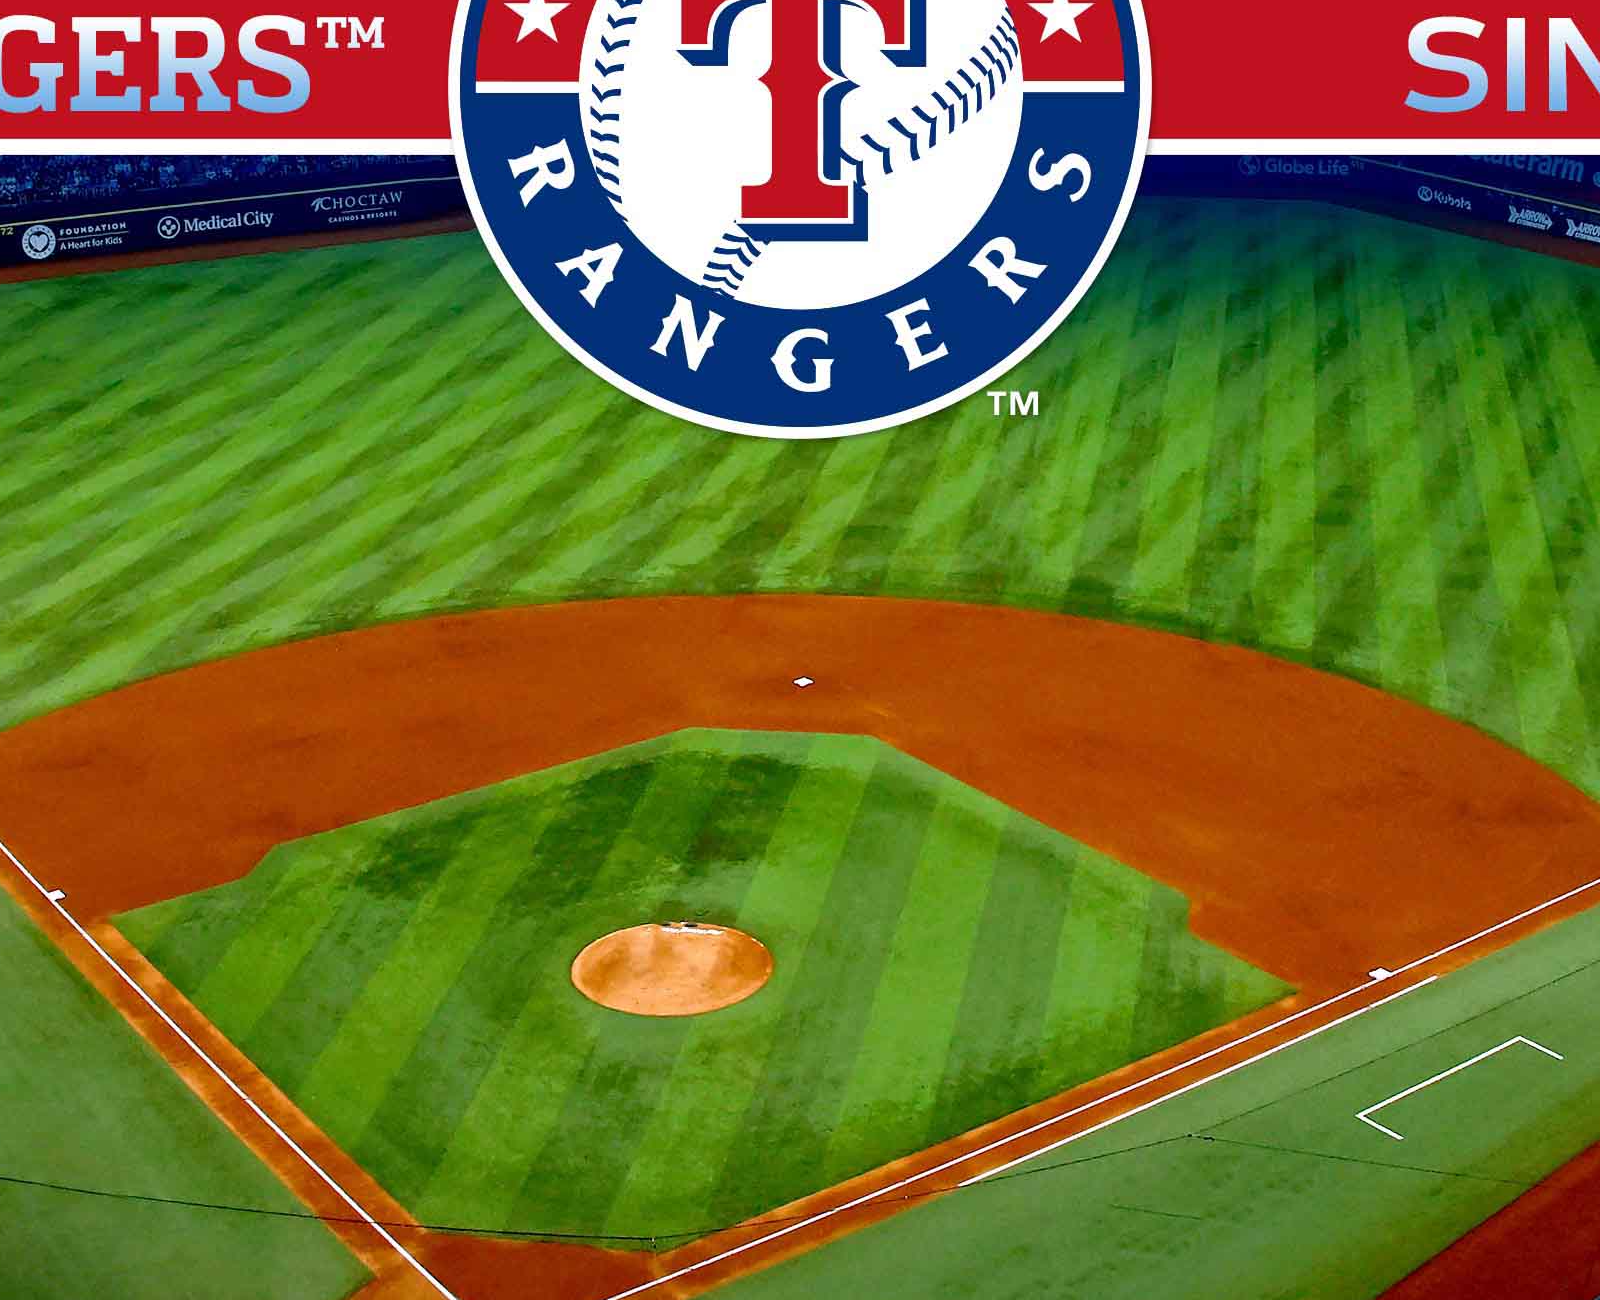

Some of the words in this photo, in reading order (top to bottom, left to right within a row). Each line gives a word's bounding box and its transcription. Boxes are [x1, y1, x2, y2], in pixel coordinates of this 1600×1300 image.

[1263, 157, 1314, 174] Globe
[1318, 159, 1349, 176] Life
[318, 191, 403, 211] CHOCTAW
[1434, 190, 1472, 210] Kubota
[59, 221, 127, 237] FOUNDATION
[184, 213, 241, 233] Medical
[243, 210, 274, 228] City
[60, 241, 67, 251] A
[68, 239, 91, 251] Heart
[92, 237, 103, 249] for
[104, 235, 123, 247] Kids
[508, 138, 1092, 392] RANGERS
